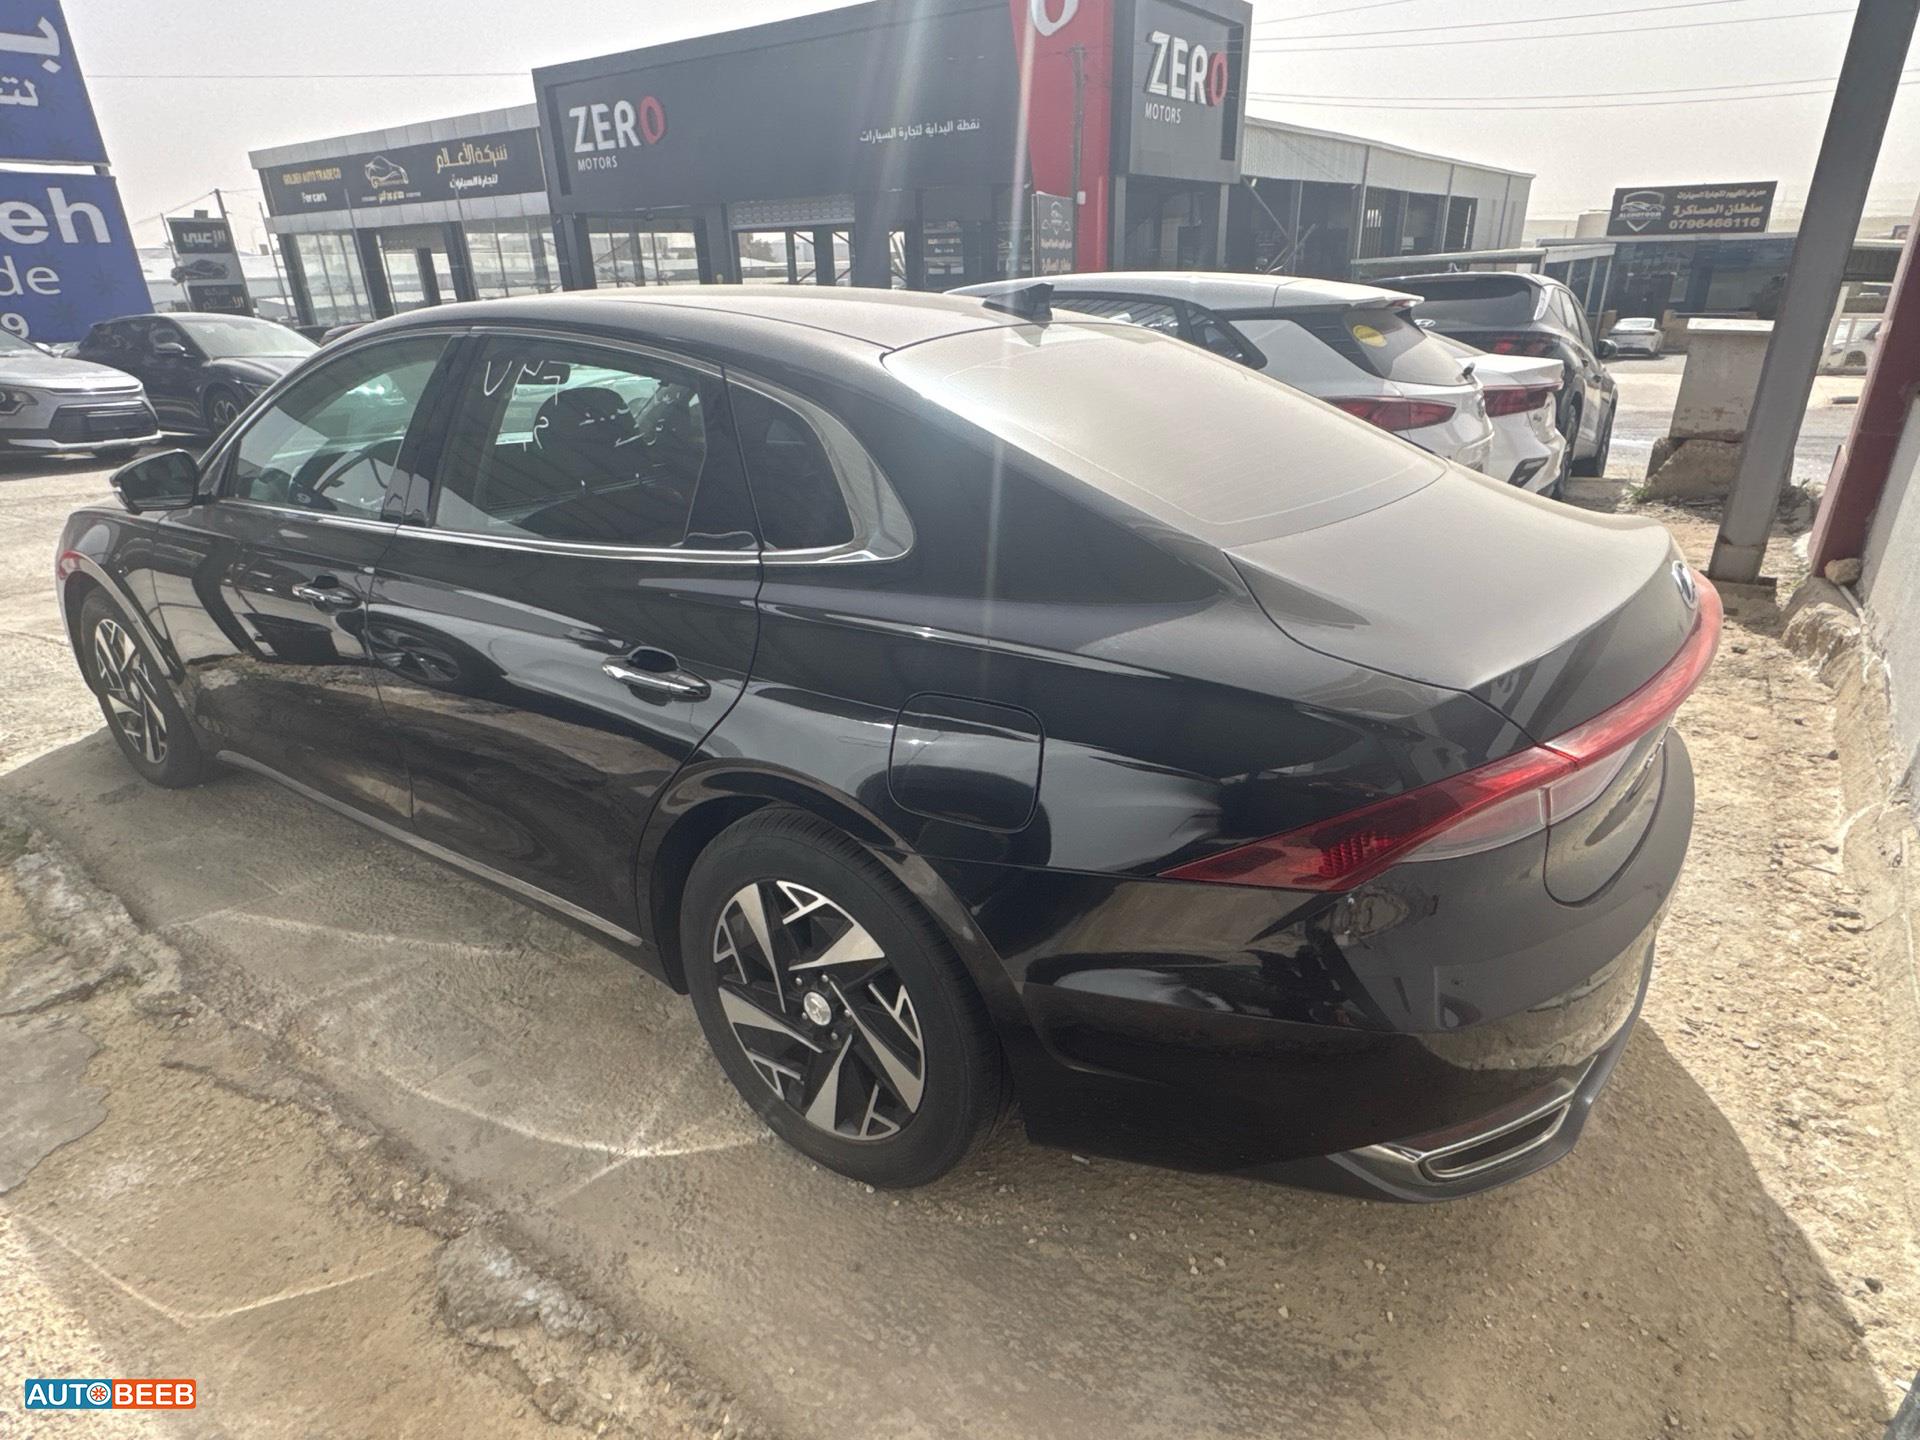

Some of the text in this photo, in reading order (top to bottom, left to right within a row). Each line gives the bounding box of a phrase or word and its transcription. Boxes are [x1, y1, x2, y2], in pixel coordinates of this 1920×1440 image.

[1149, 30, 1228, 106] ZERO
[569, 96, 665, 153] ZERO
[1145, 102, 1181, 124] MOTORS
[859, 118, 980, 144] نقطة البداية لتجارة السيارات
[474, 144, 508, 167] شركة
[578, 155, 618, 171] MOTORS
[1724, 203, 1764, 216] سلطان
